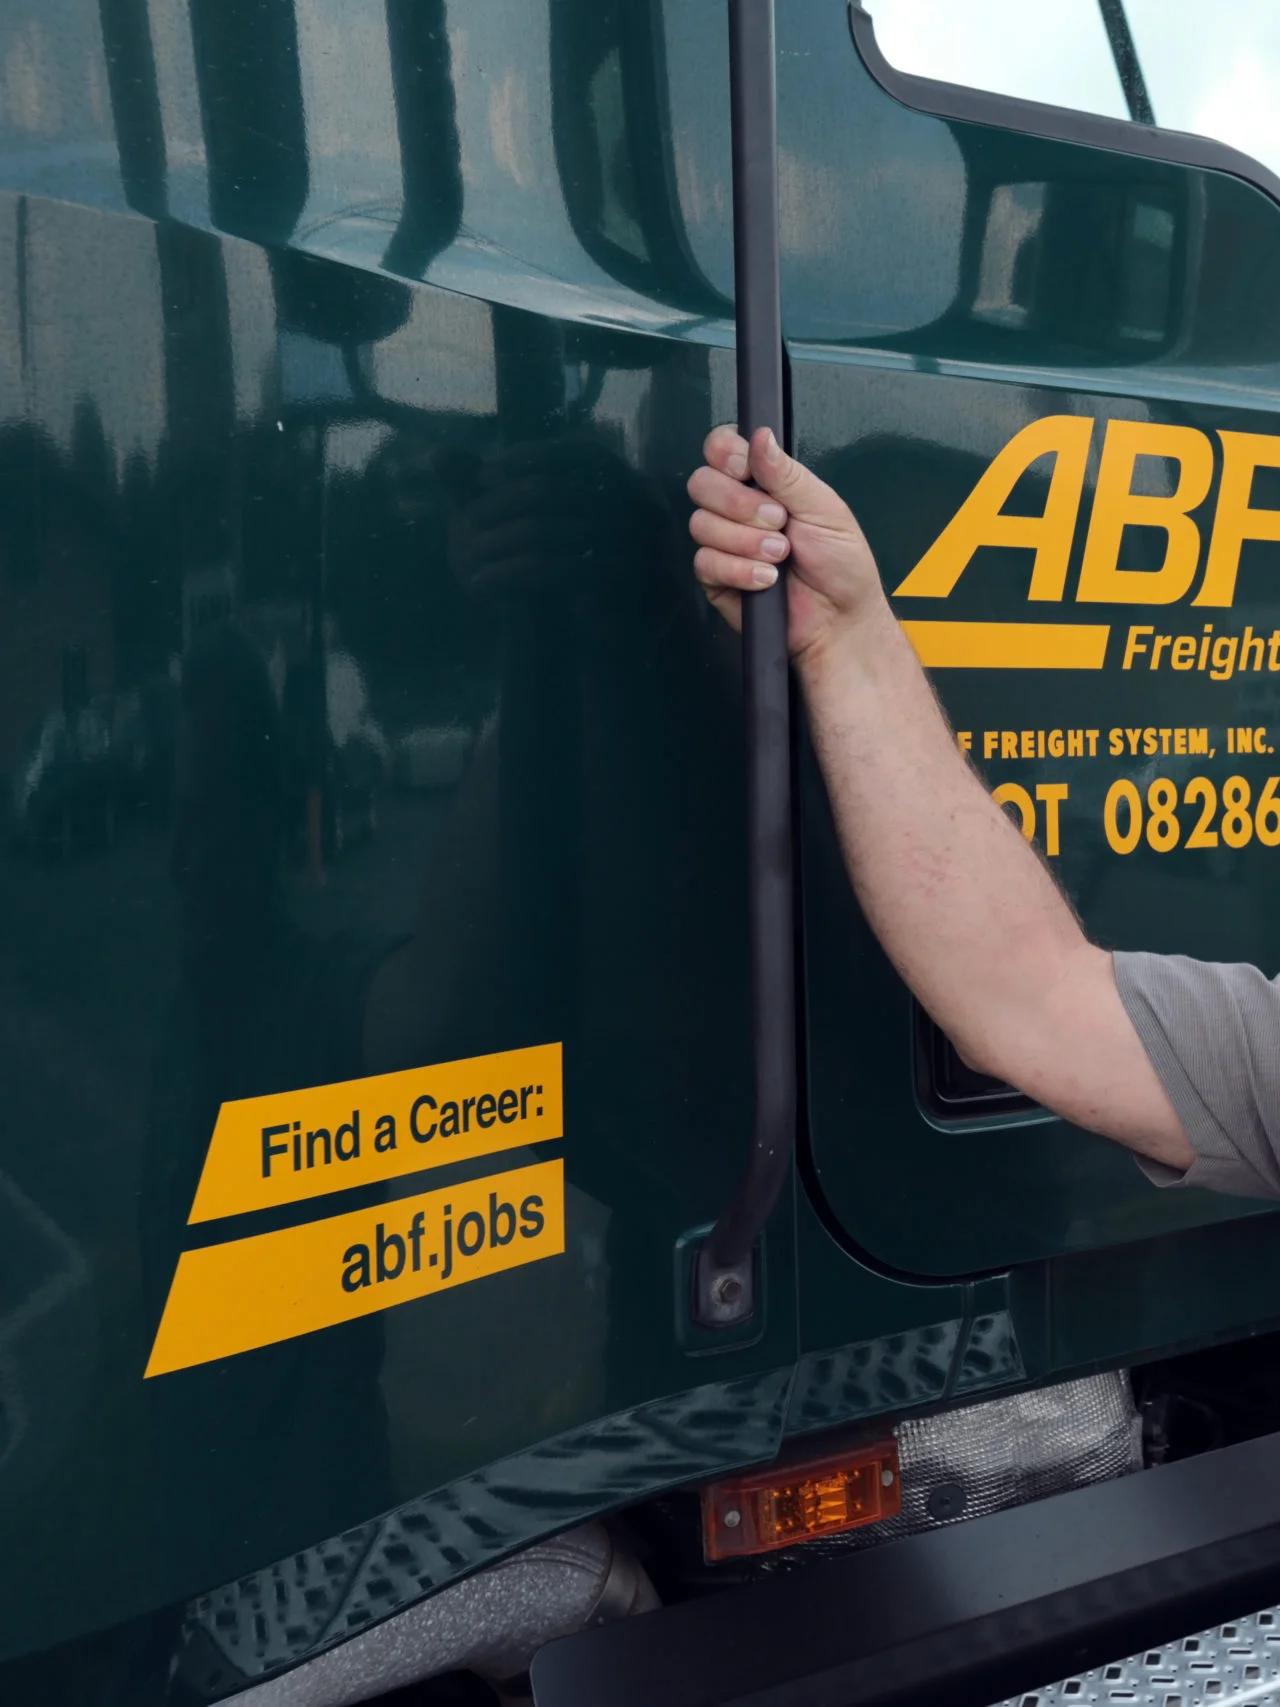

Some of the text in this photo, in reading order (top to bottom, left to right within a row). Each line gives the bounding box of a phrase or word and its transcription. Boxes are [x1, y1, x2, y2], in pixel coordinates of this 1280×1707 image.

[984, 729, 1100, 759] FREIGHT
[1109, 727, 1216, 759] SYSTEM,
[1227, 727, 1275, 754] INC.
[991, 782, 1069, 856] OT
[261, 1084, 544, 1178] Find a Career:
[341, 1192, 545, 1293] abf.jobs
